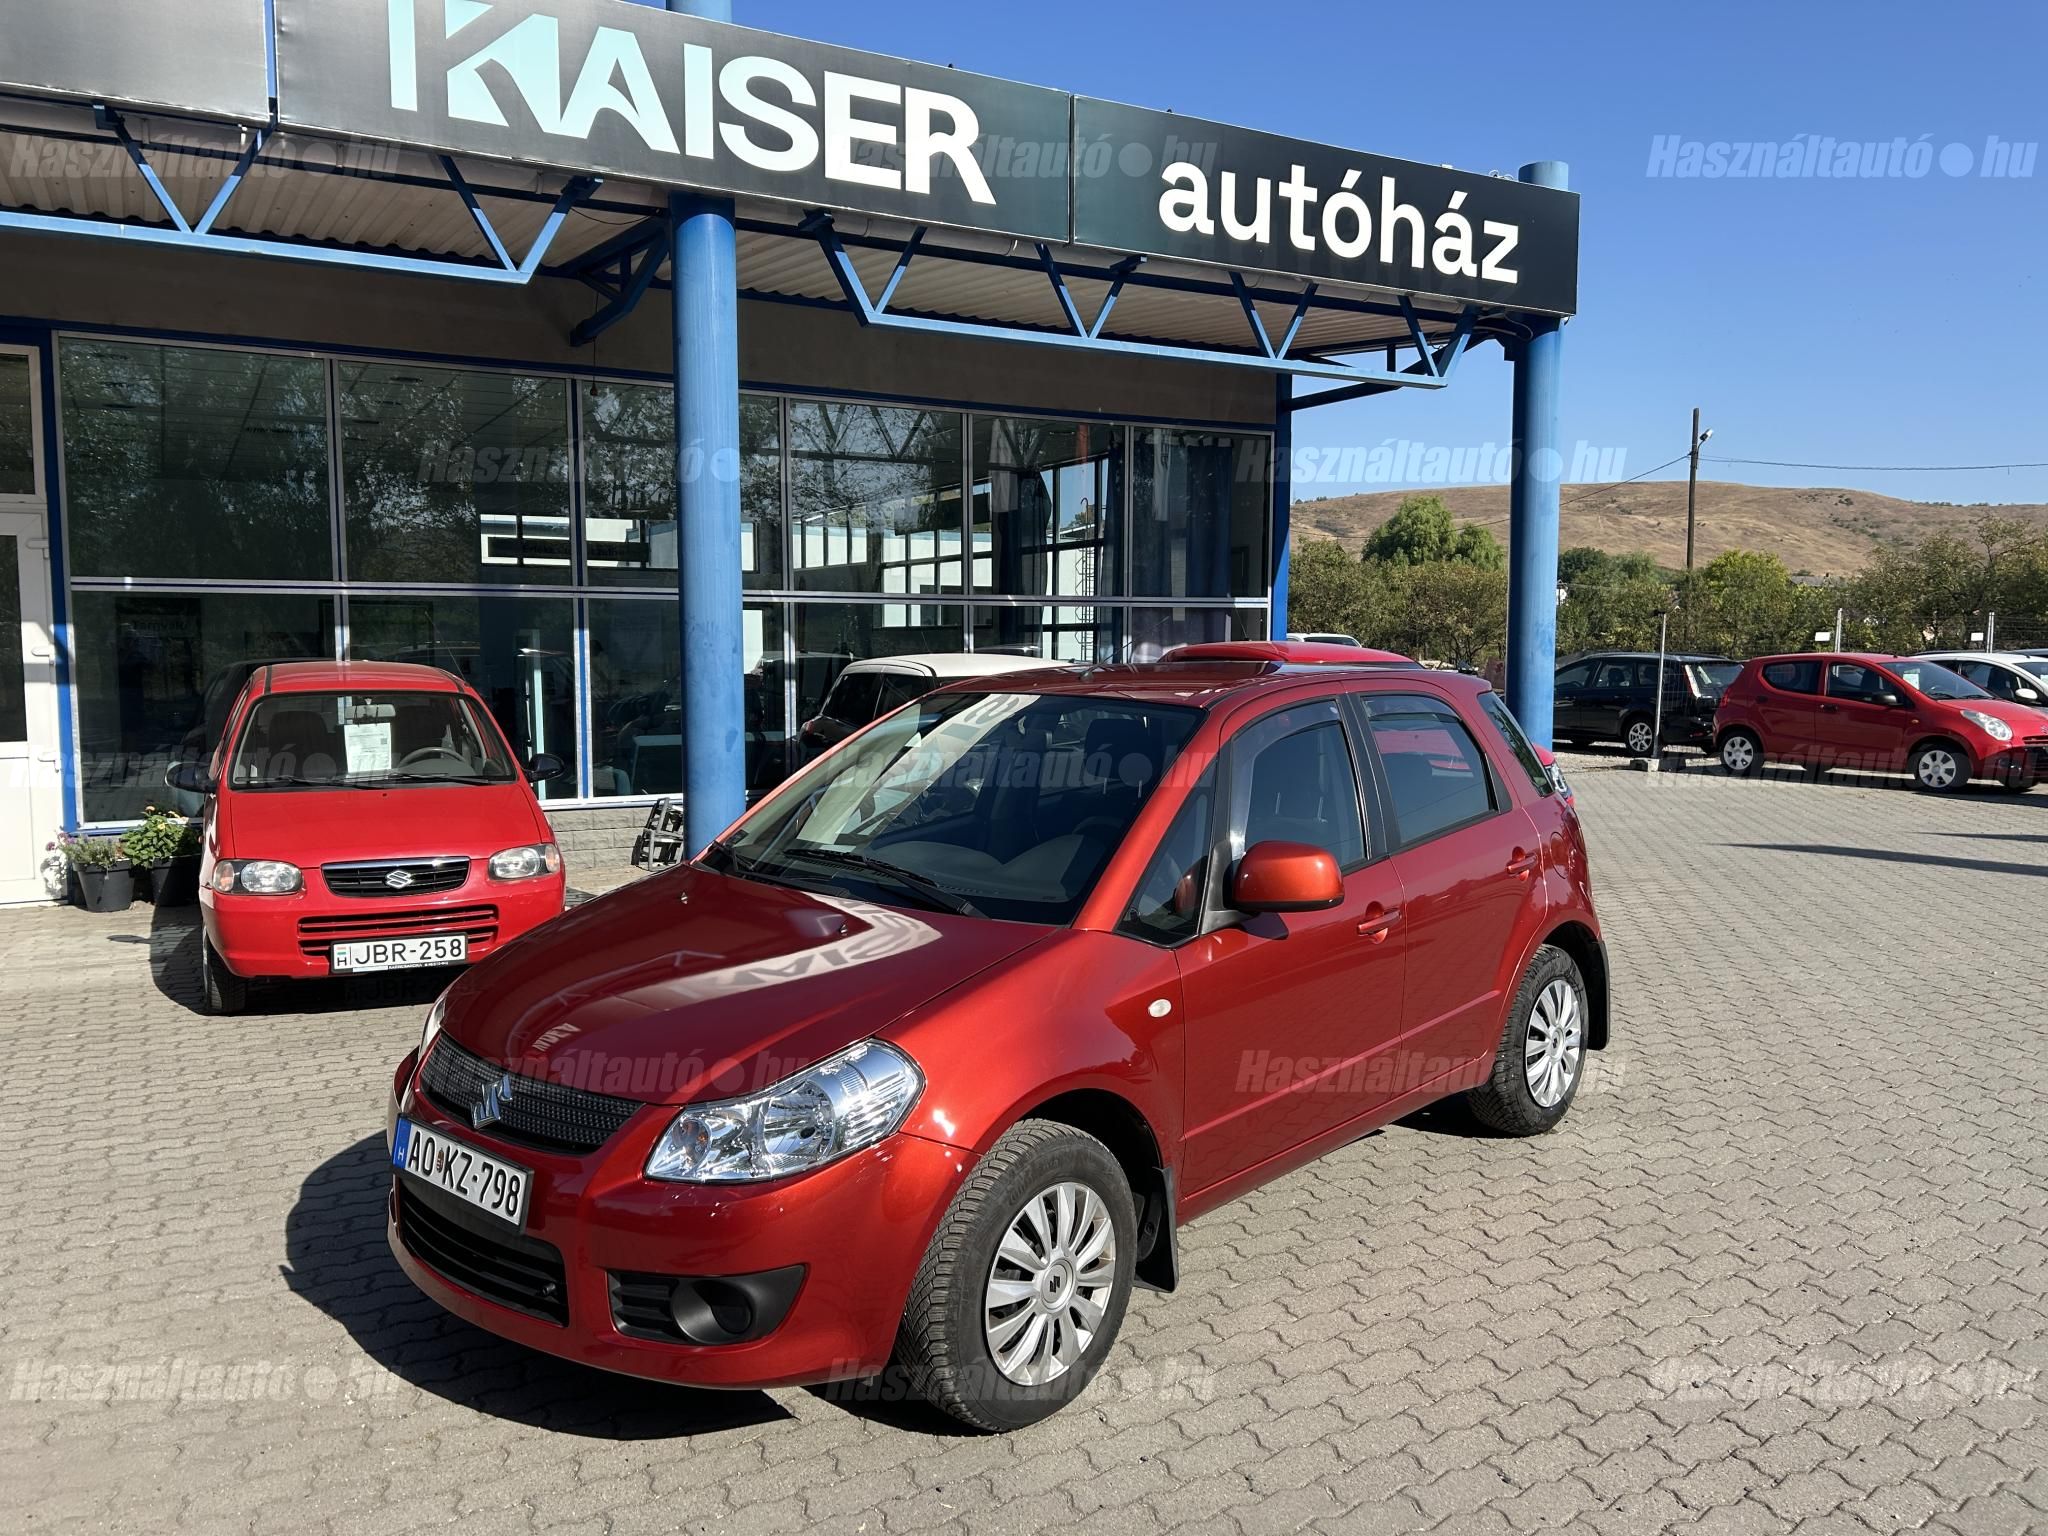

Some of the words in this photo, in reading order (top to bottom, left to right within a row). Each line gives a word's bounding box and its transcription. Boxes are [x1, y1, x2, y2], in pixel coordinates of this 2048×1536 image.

[386, 0, 997, 205] KAISER
[1159, 161, 1518, 284] autóház
[355, 938, 462, 965] JBR-258
